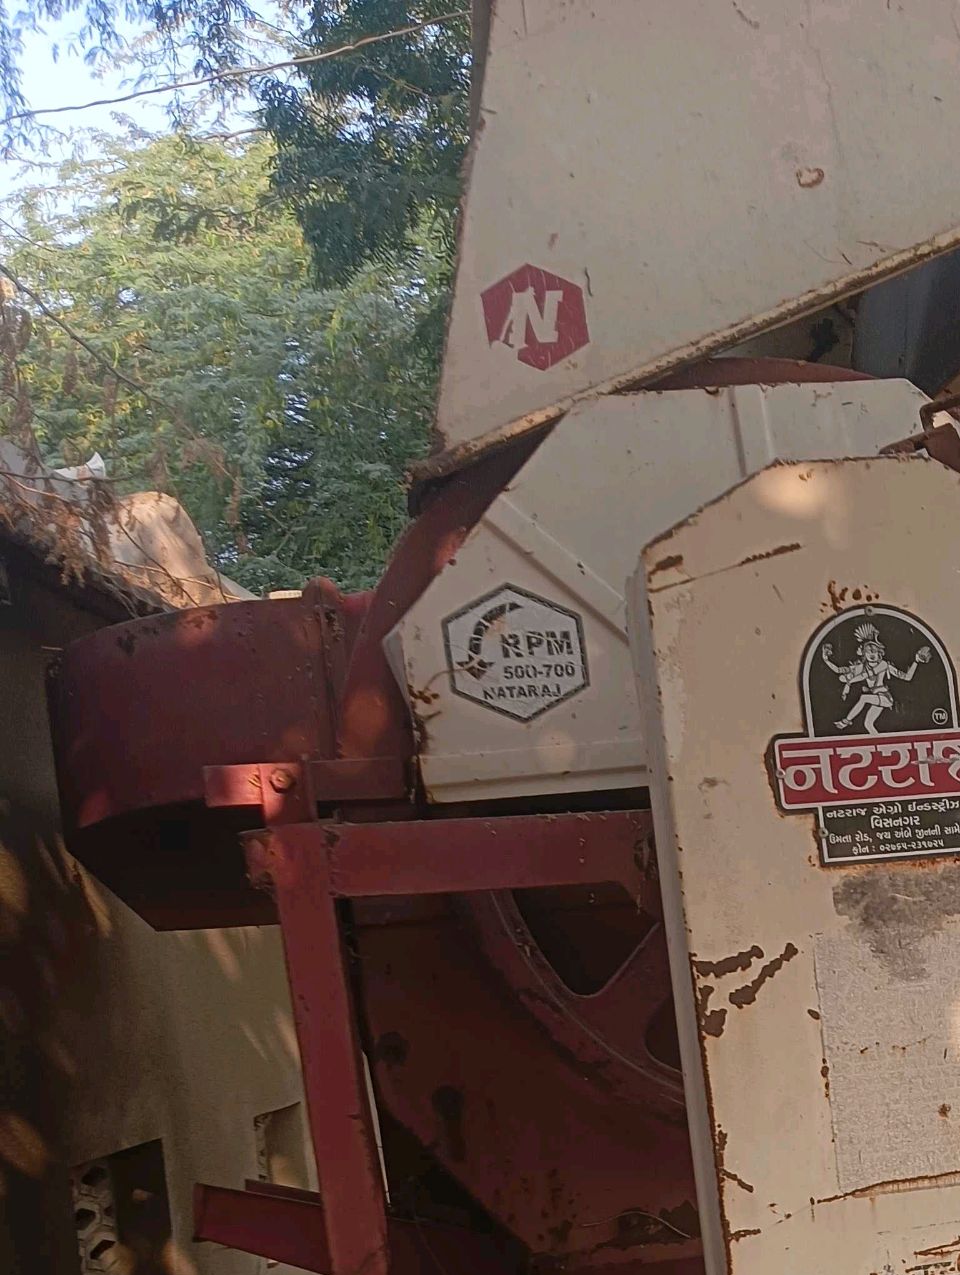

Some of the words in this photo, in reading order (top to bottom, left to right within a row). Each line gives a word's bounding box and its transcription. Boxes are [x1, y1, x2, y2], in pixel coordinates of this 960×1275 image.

[500, 630, 575, 659] RPM
[502, 661, 576, 680] 500-700
[482, 683, 563, 701] NATARAJ
[825, 806, 868, 819] નટરાજ
[872, 802, 902, 815] એગ્રો
[870, 815, 921, 829] વિસનગર
[829, 832, 852, 844] ઉમતા
[876, 830, 892, 840] જય
[894, 827, 912, 838] અંબે
[851, 842, 869, 855] ફોન
